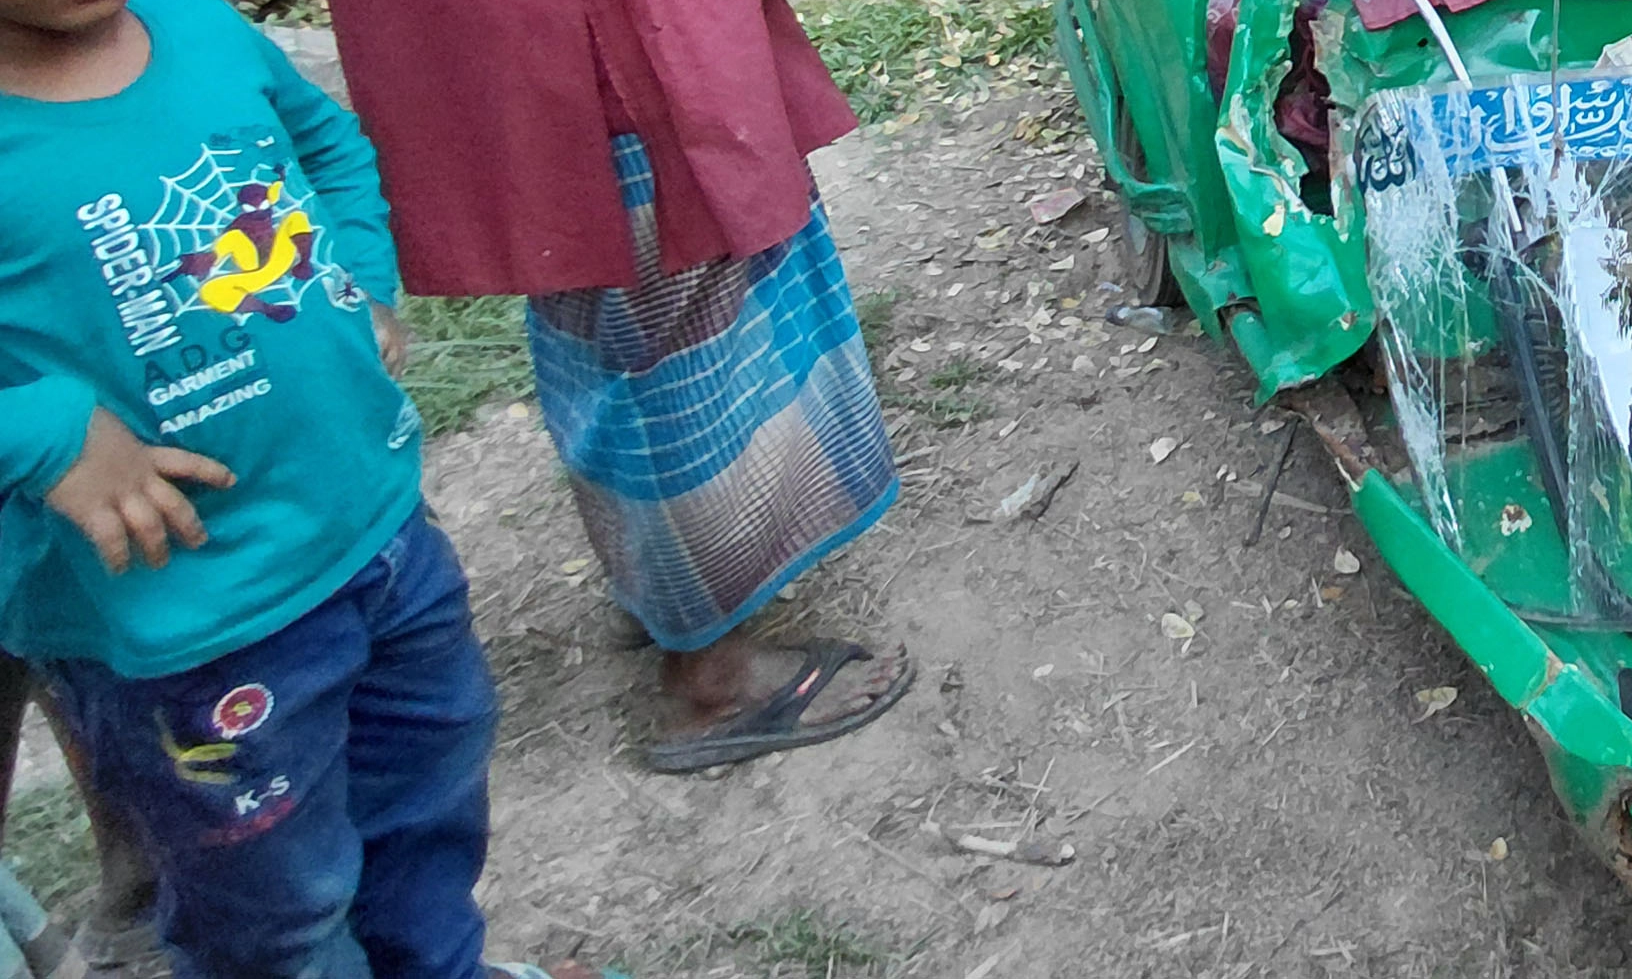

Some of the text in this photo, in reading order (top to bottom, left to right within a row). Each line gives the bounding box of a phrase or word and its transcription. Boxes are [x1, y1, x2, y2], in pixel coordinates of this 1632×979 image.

[77, 193, 182, 357] SPIDER-MAN
[148, 349, 256, 405] GARMENT
[159, 378, 272, 434] AMAZING
